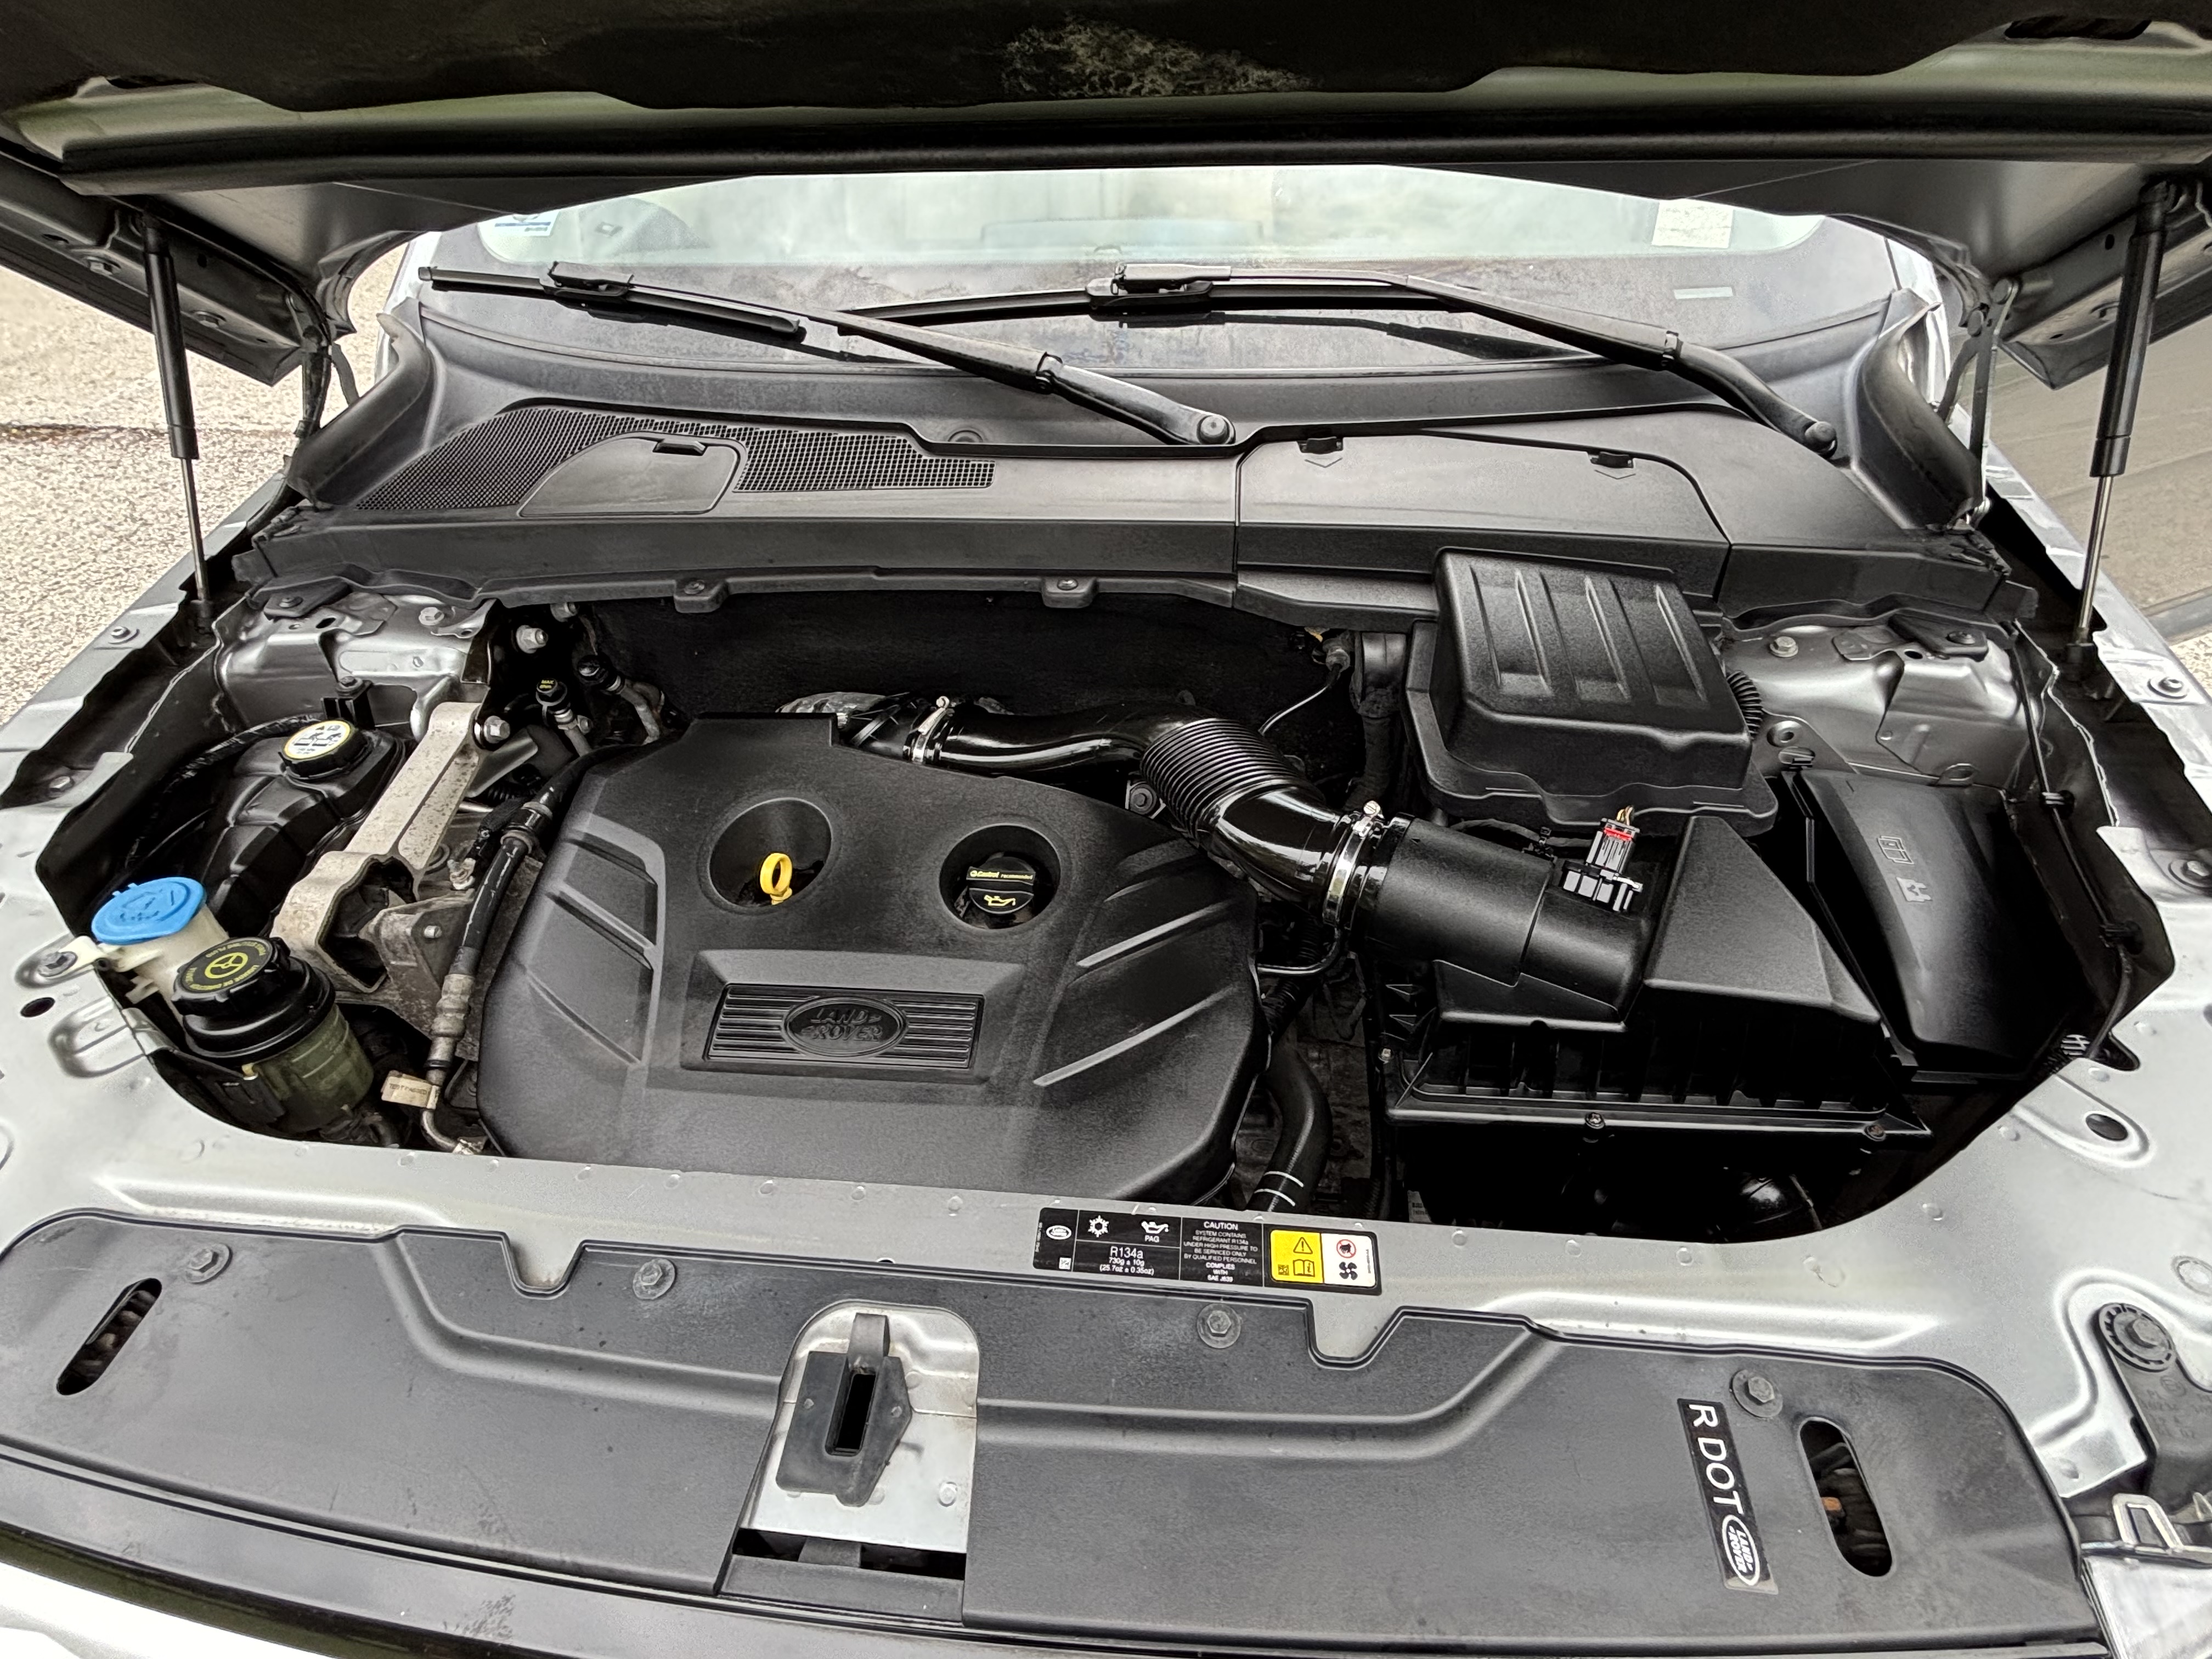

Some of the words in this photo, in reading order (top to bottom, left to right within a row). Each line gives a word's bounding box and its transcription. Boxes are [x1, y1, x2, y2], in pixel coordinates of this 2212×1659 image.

[810, 1008, 869, 1025] LAND
[811, 1025, 883, 1041] ROVER
[1204, 1221, 1238, 1231] CAUTION
[1144, 1235, 1160, 1243] PAG
[1110, 1245, 1144, 1259] R134a
[1133, 1259, 1145, 1267] 10g
[1206, 1262, 1235, 1270] COMPLIES
[1223, 1256, 1257, 1265] PERSONNEL
[1729, 1532, 1747, 1573] ROVER
[1736, 1529, 1753, 1565] LAND
